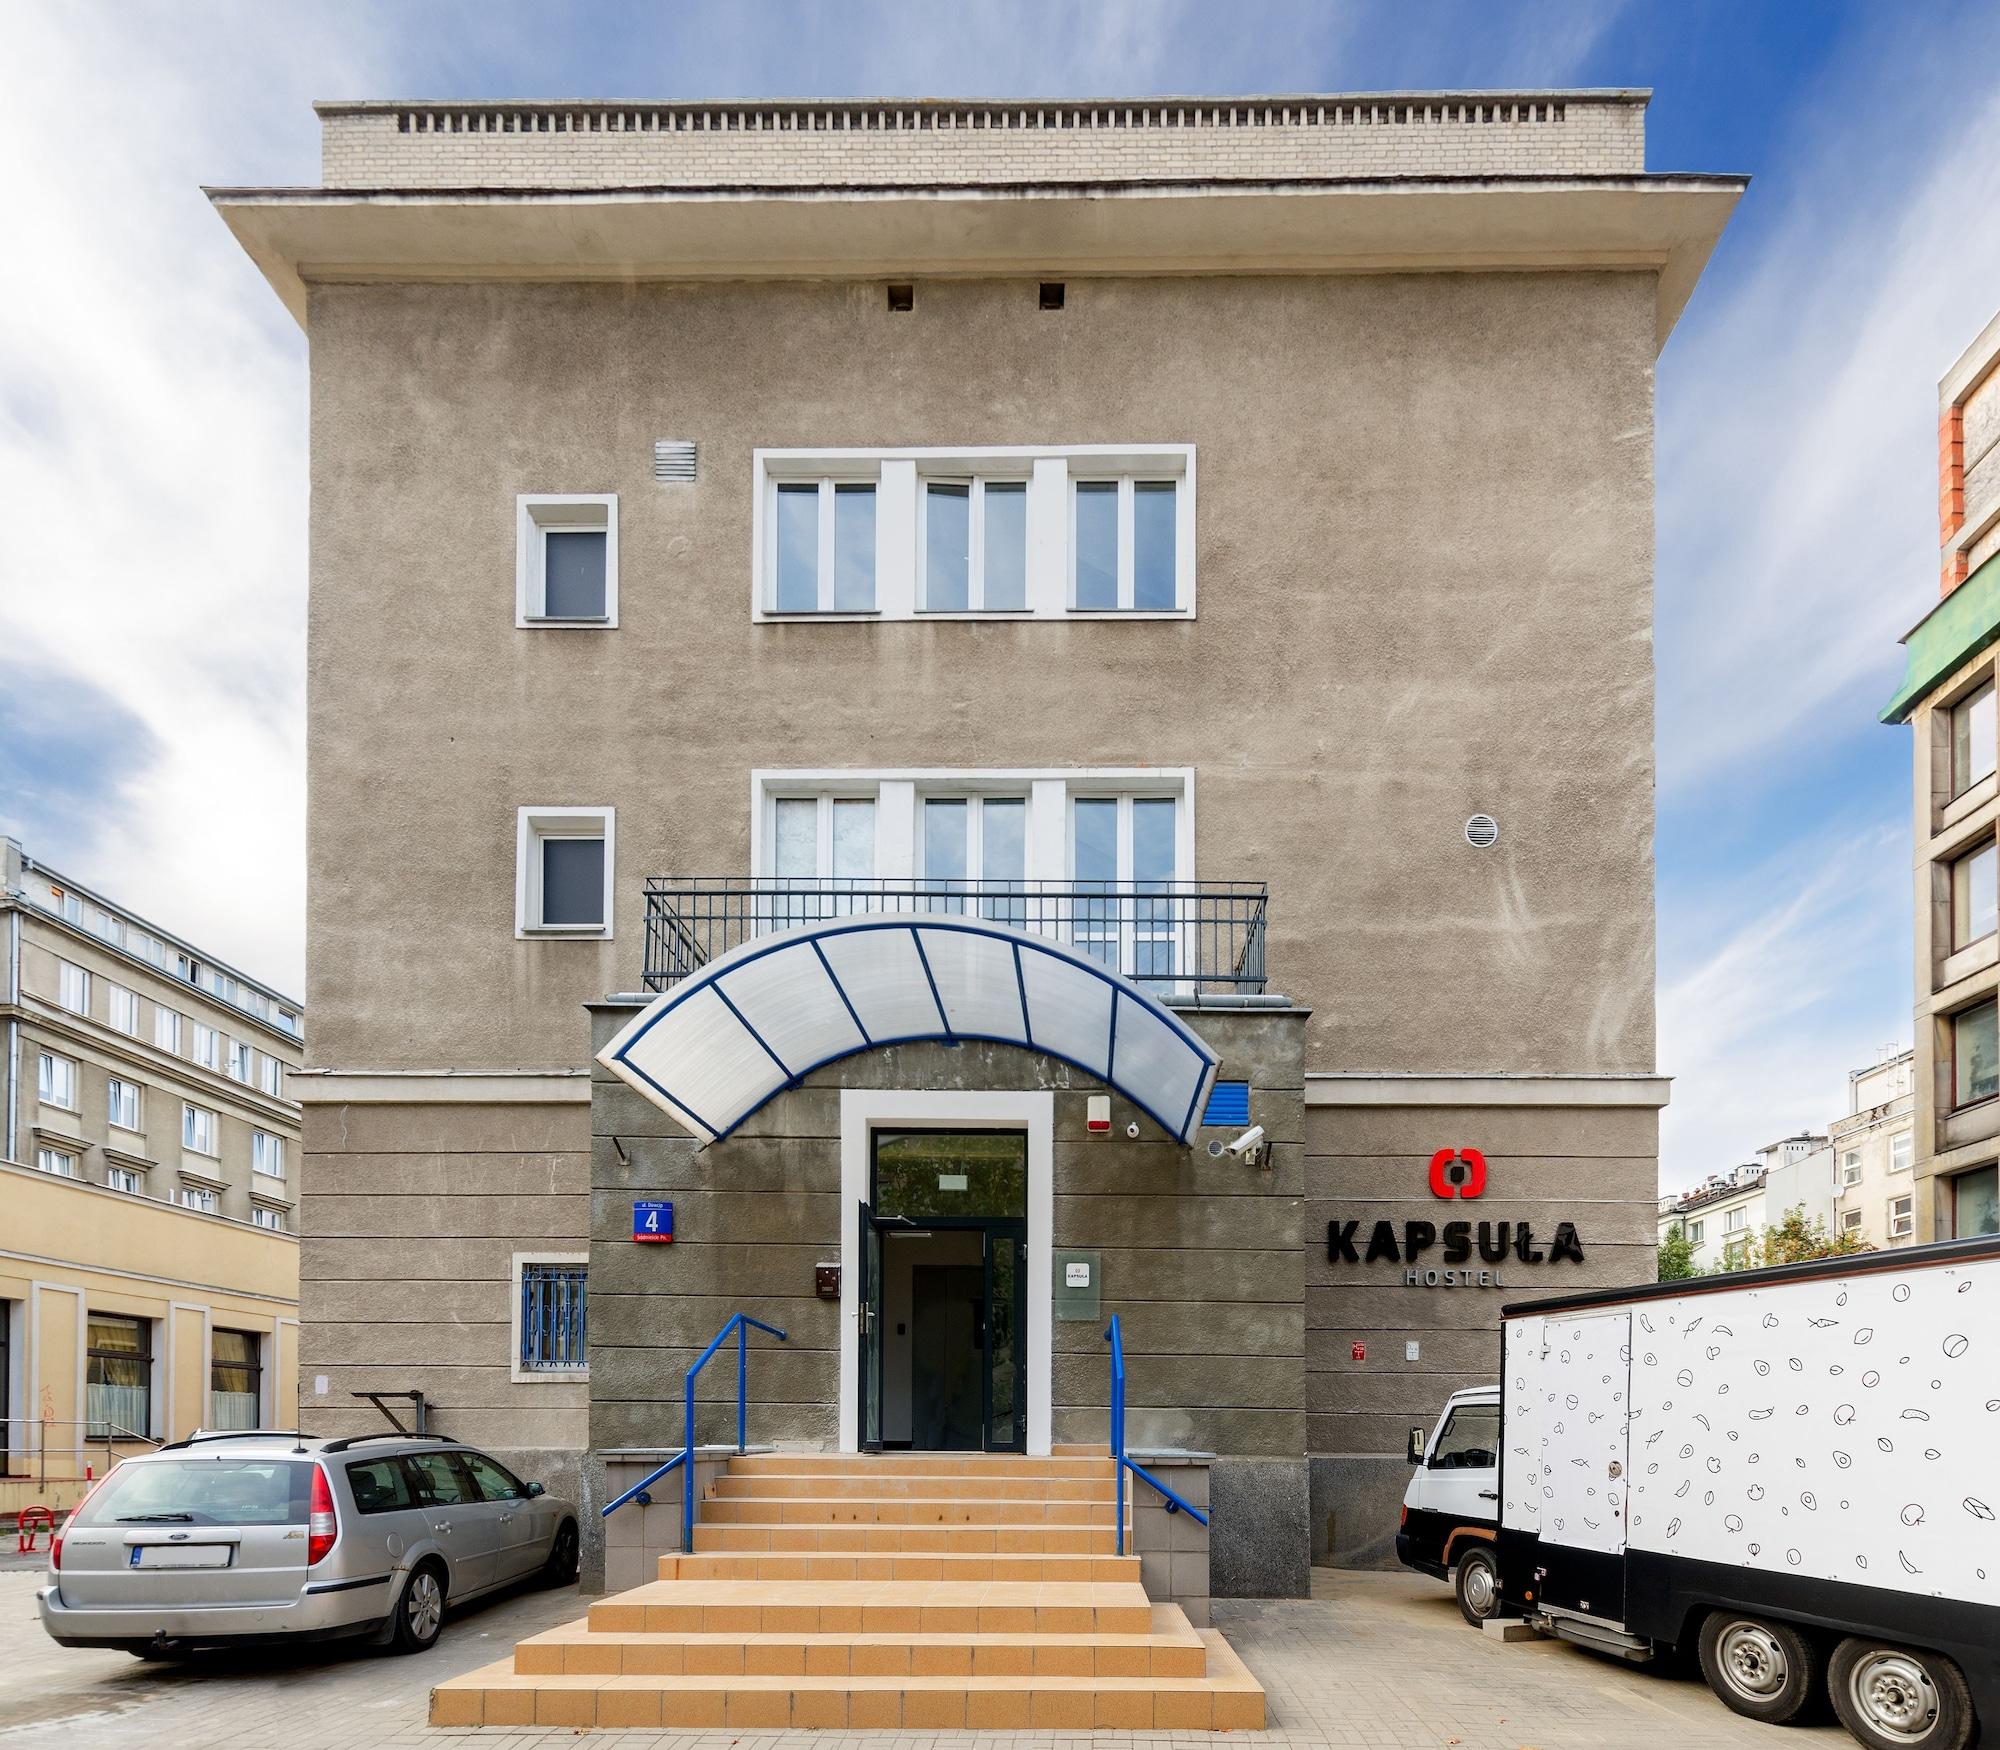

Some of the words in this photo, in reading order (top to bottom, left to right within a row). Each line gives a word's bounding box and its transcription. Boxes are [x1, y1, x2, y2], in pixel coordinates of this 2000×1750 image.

[645, 1211, 658, 1232] 4
[1328, 1220, 1585, 1263] KAPSUŁA
[1406, 1269, 1505, 1288] HOSTEL
